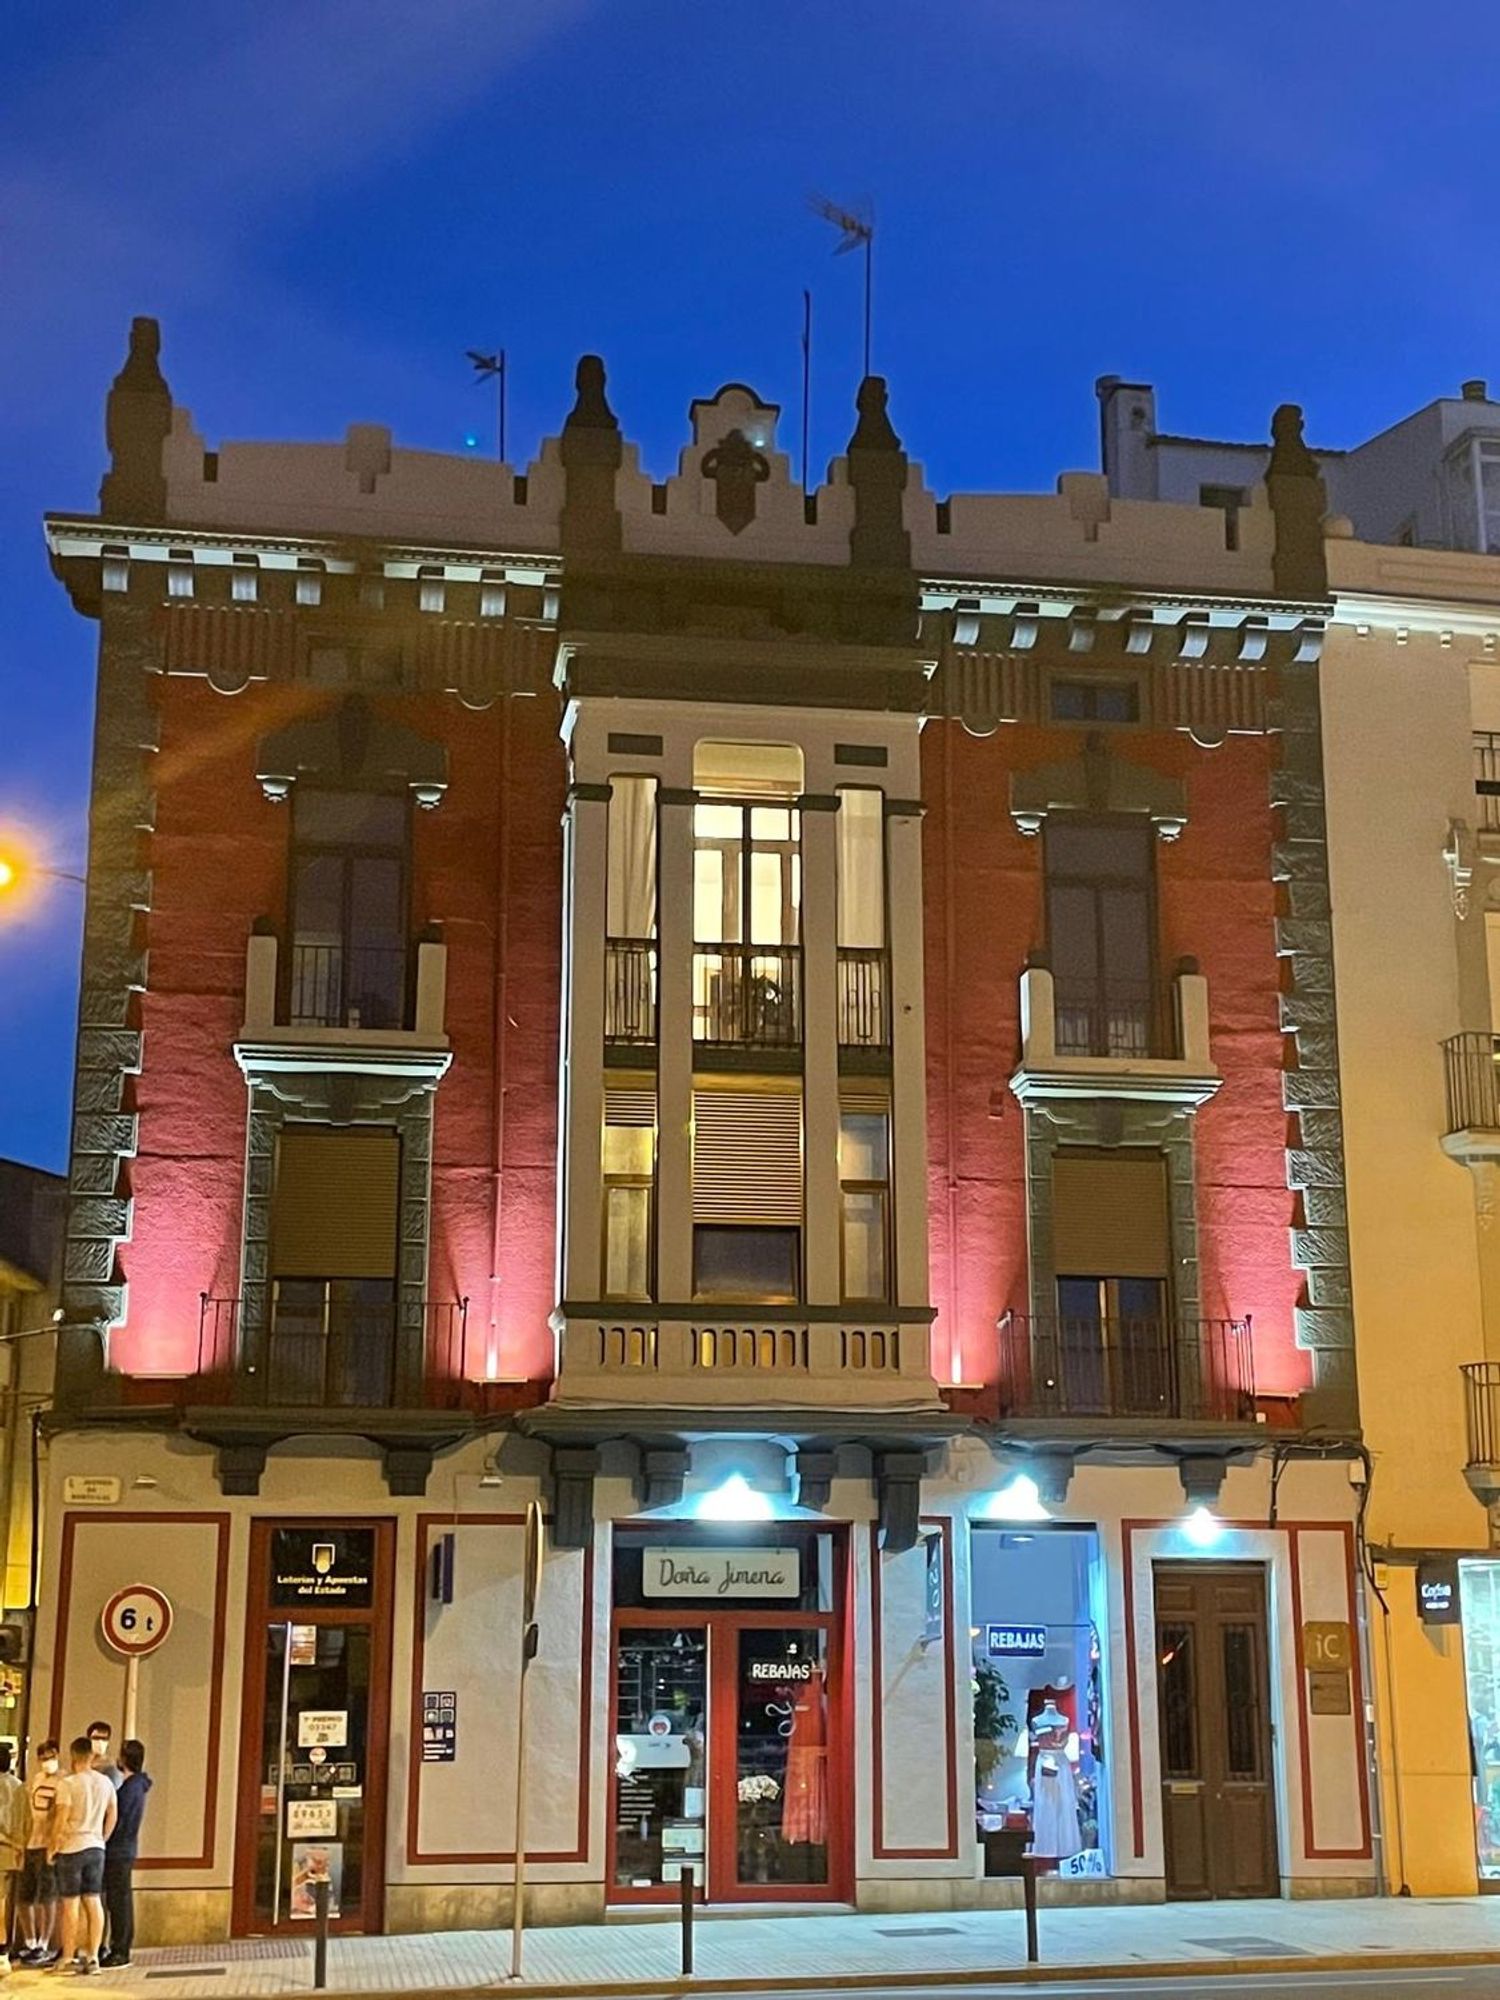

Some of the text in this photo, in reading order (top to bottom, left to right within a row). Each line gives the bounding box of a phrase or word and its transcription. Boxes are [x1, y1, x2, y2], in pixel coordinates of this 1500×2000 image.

[316, 1577, 323, 1586] y
[324, 1575, 368, 1586] Apuestas
[660, 1558, 785, 1594] Doña Jimena
[314, 1586, 347, 1595] Estado
[120, 1608, 154, 1631] 6 t
[990, 1631, 1046, 1650] REBAJAS
[752, 1663, 810, 1680] REBAJAS
